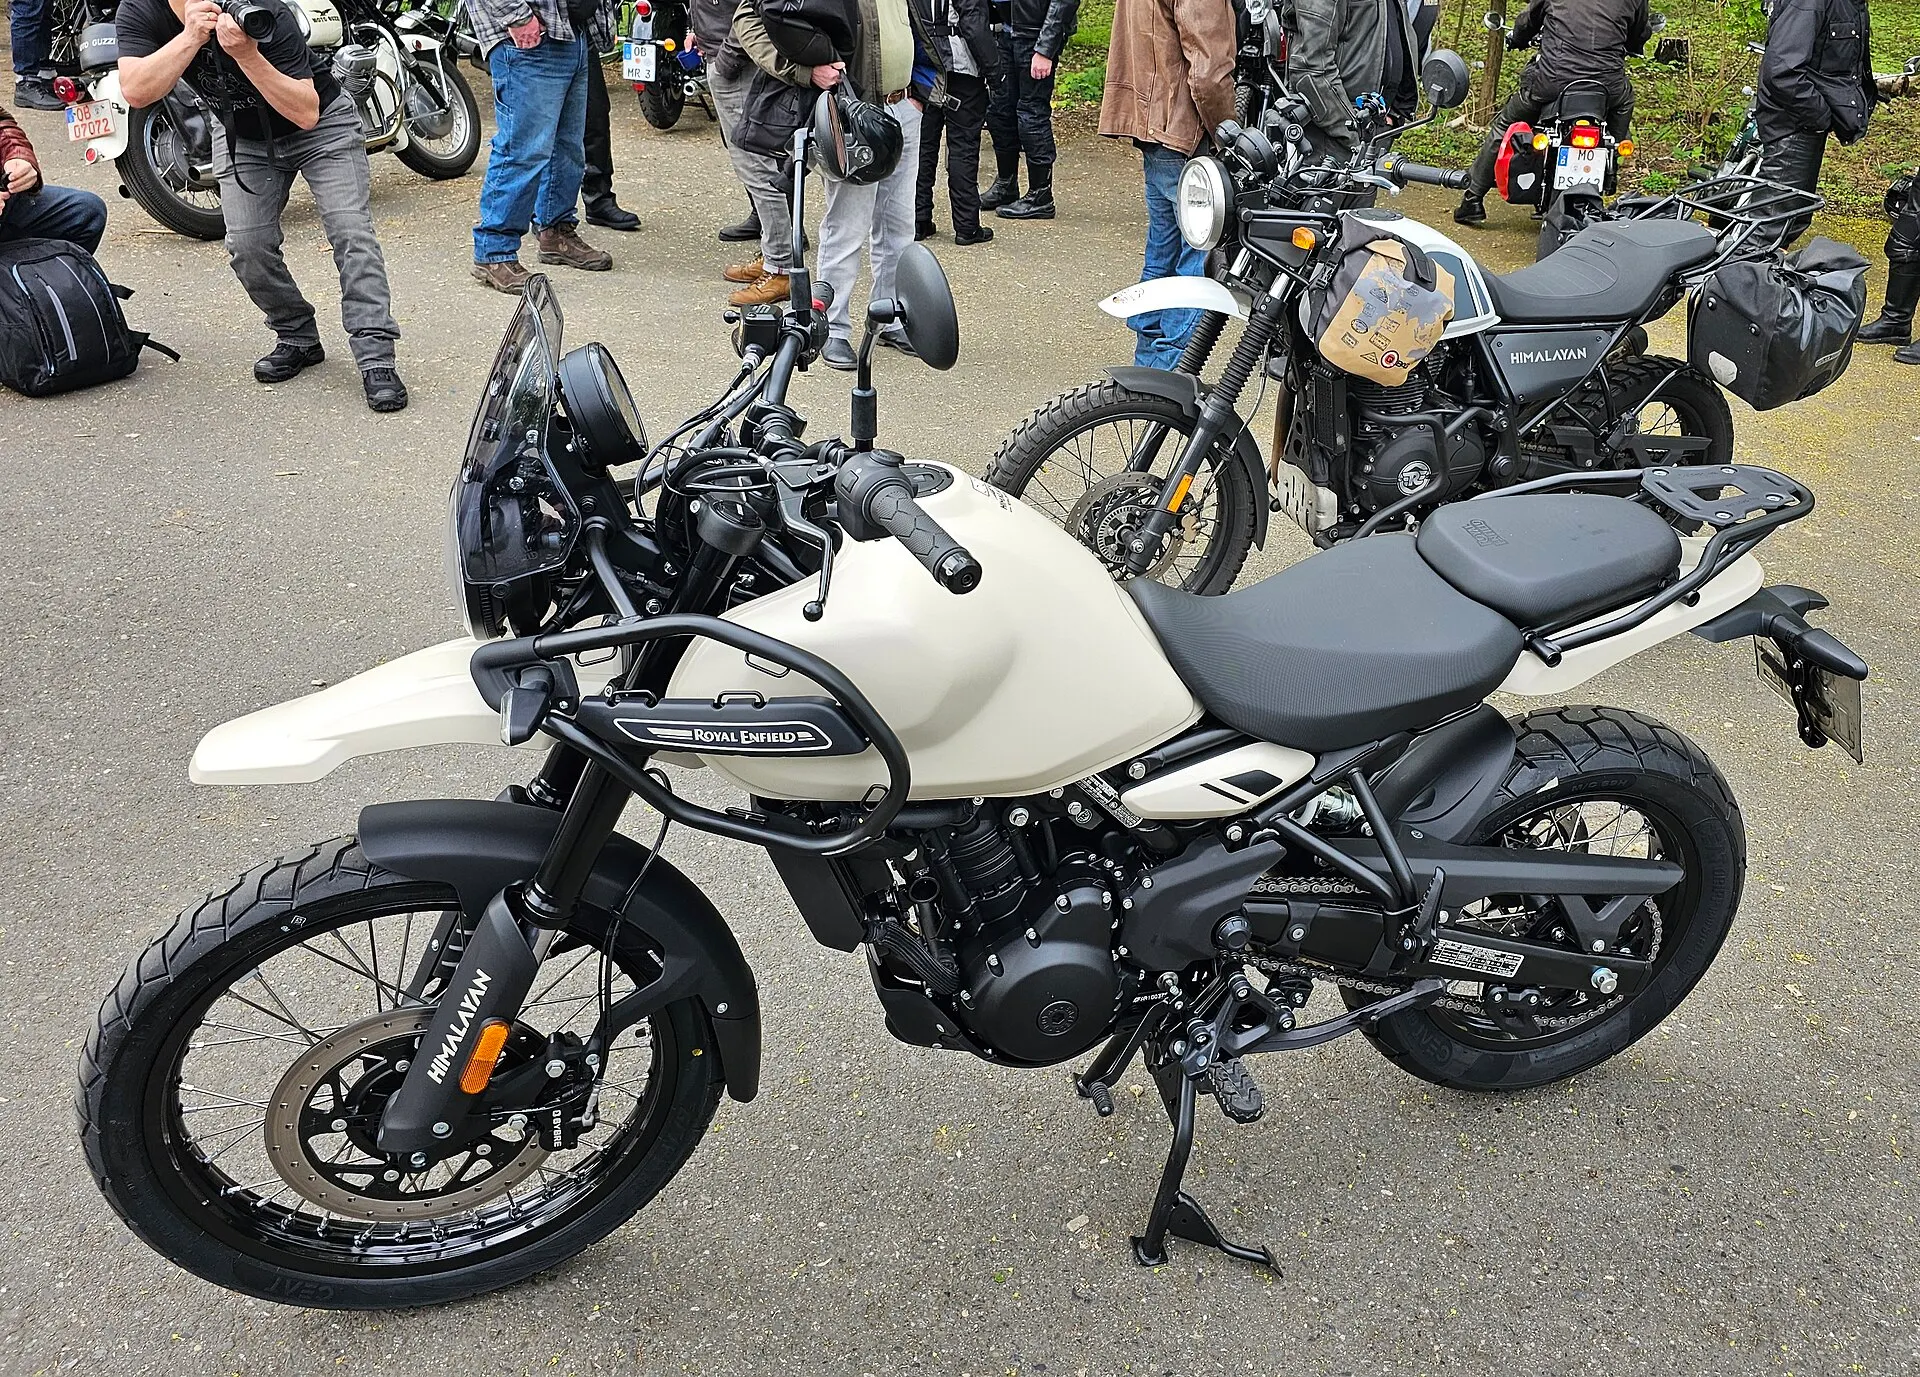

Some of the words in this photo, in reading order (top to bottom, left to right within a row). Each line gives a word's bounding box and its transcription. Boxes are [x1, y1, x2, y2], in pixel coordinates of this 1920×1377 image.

[92, 38, 117, 47] GUZZI
[634, 46, 647, 57] OB
[628, 68, 641, 78] MR
[645, 70, 651, 79] 3
[77, 105, 92, 122] OB
[73, 118, 111, 139] 07072
[1578, 149, 1595, 161] MO
[1510, 347, 1587, 364] HIMALAYAN
[693, 728, 739, 743] ROYAL
[739, 730, 796, 744] ENFIELD
[426, 968, 492, 1085] HIMALAYAN
[553, 1121, 562, 1148] BYBRE
